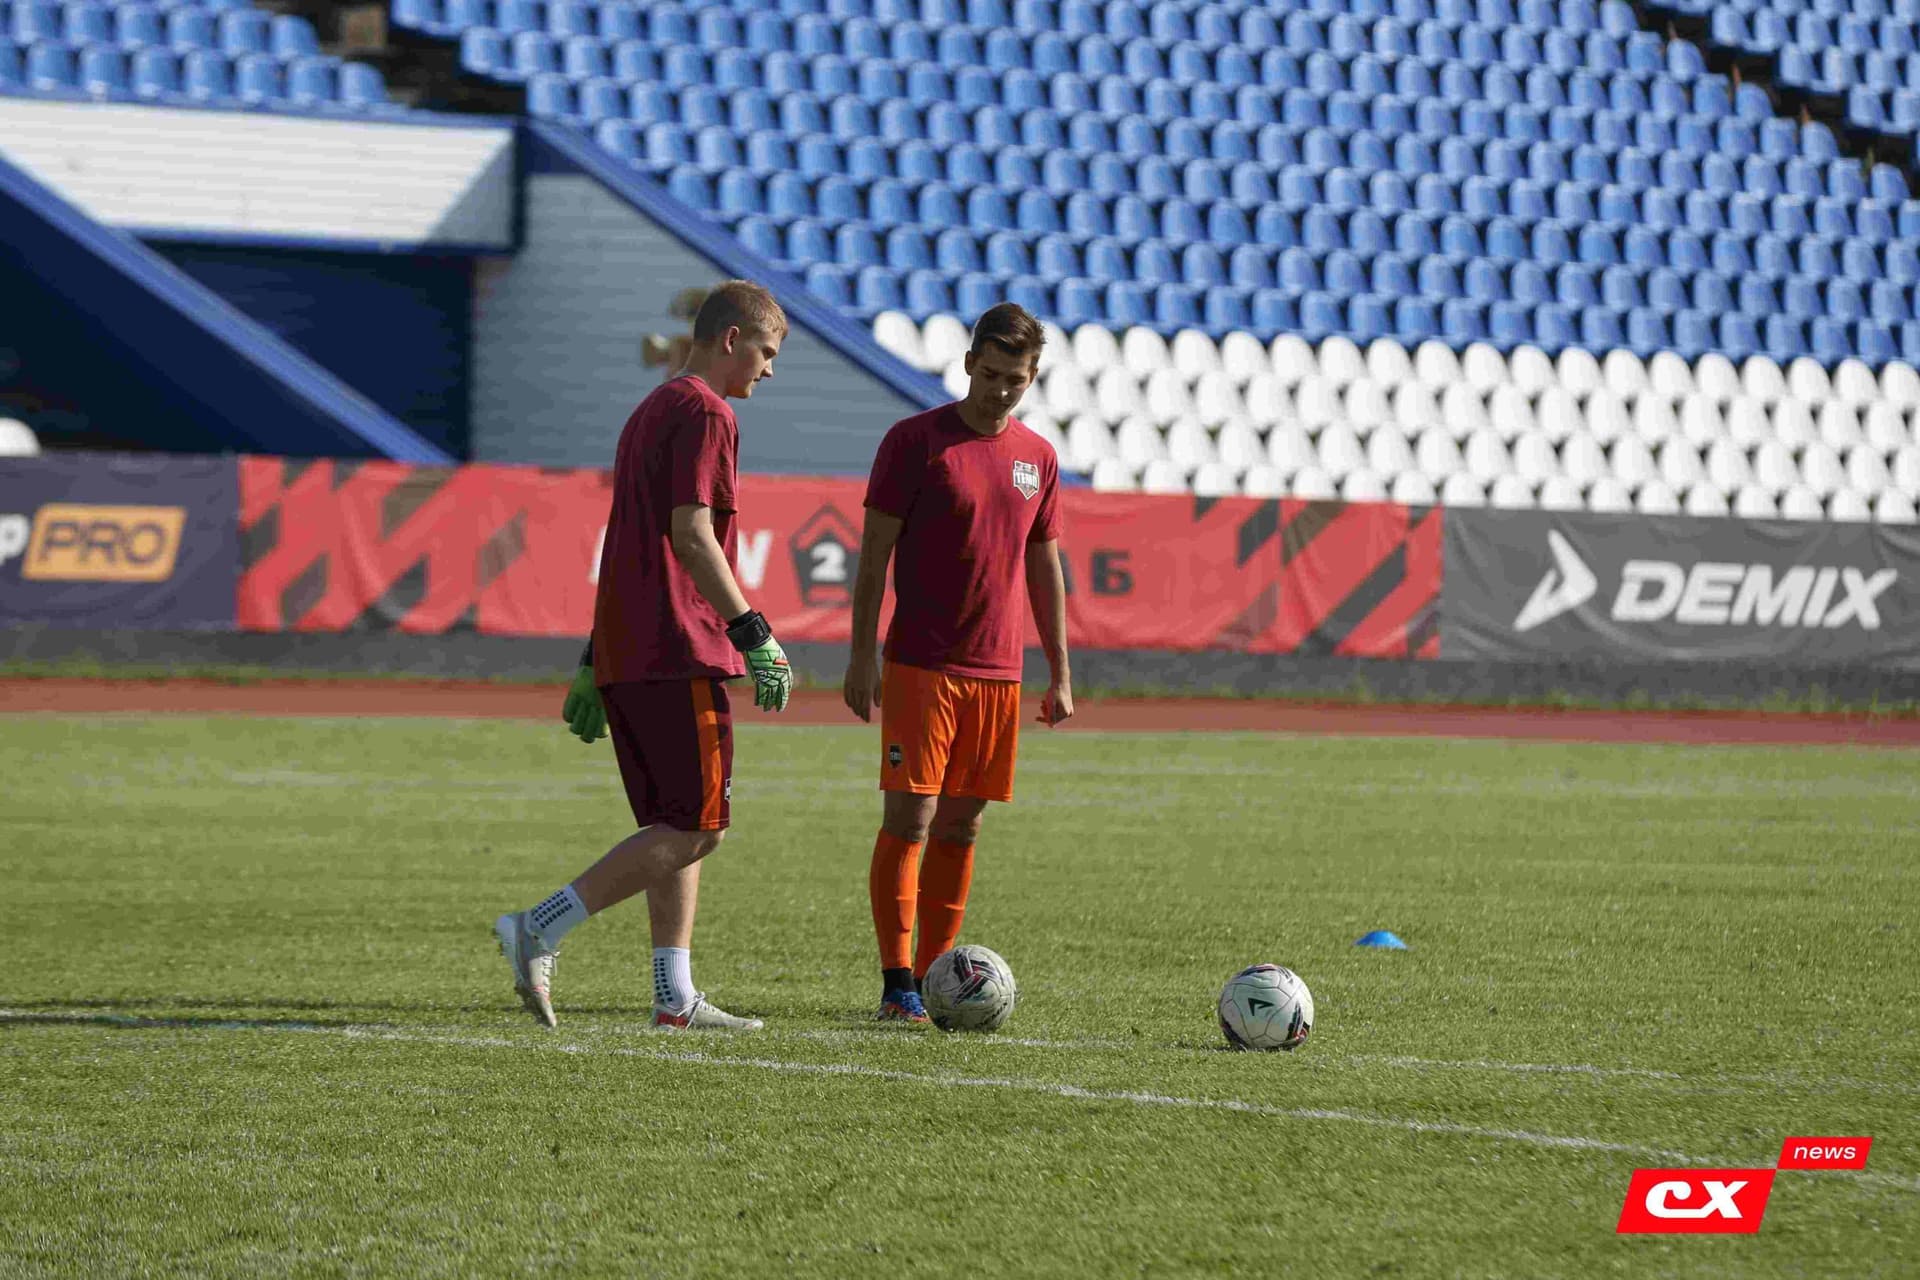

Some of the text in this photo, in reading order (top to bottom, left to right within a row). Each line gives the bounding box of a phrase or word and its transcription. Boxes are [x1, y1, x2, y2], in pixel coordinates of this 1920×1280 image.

[37, 520, 165, 564] PRO
[810, 541, 847, 583] 2
[1611, 560, 1898, 630] DEMIX
